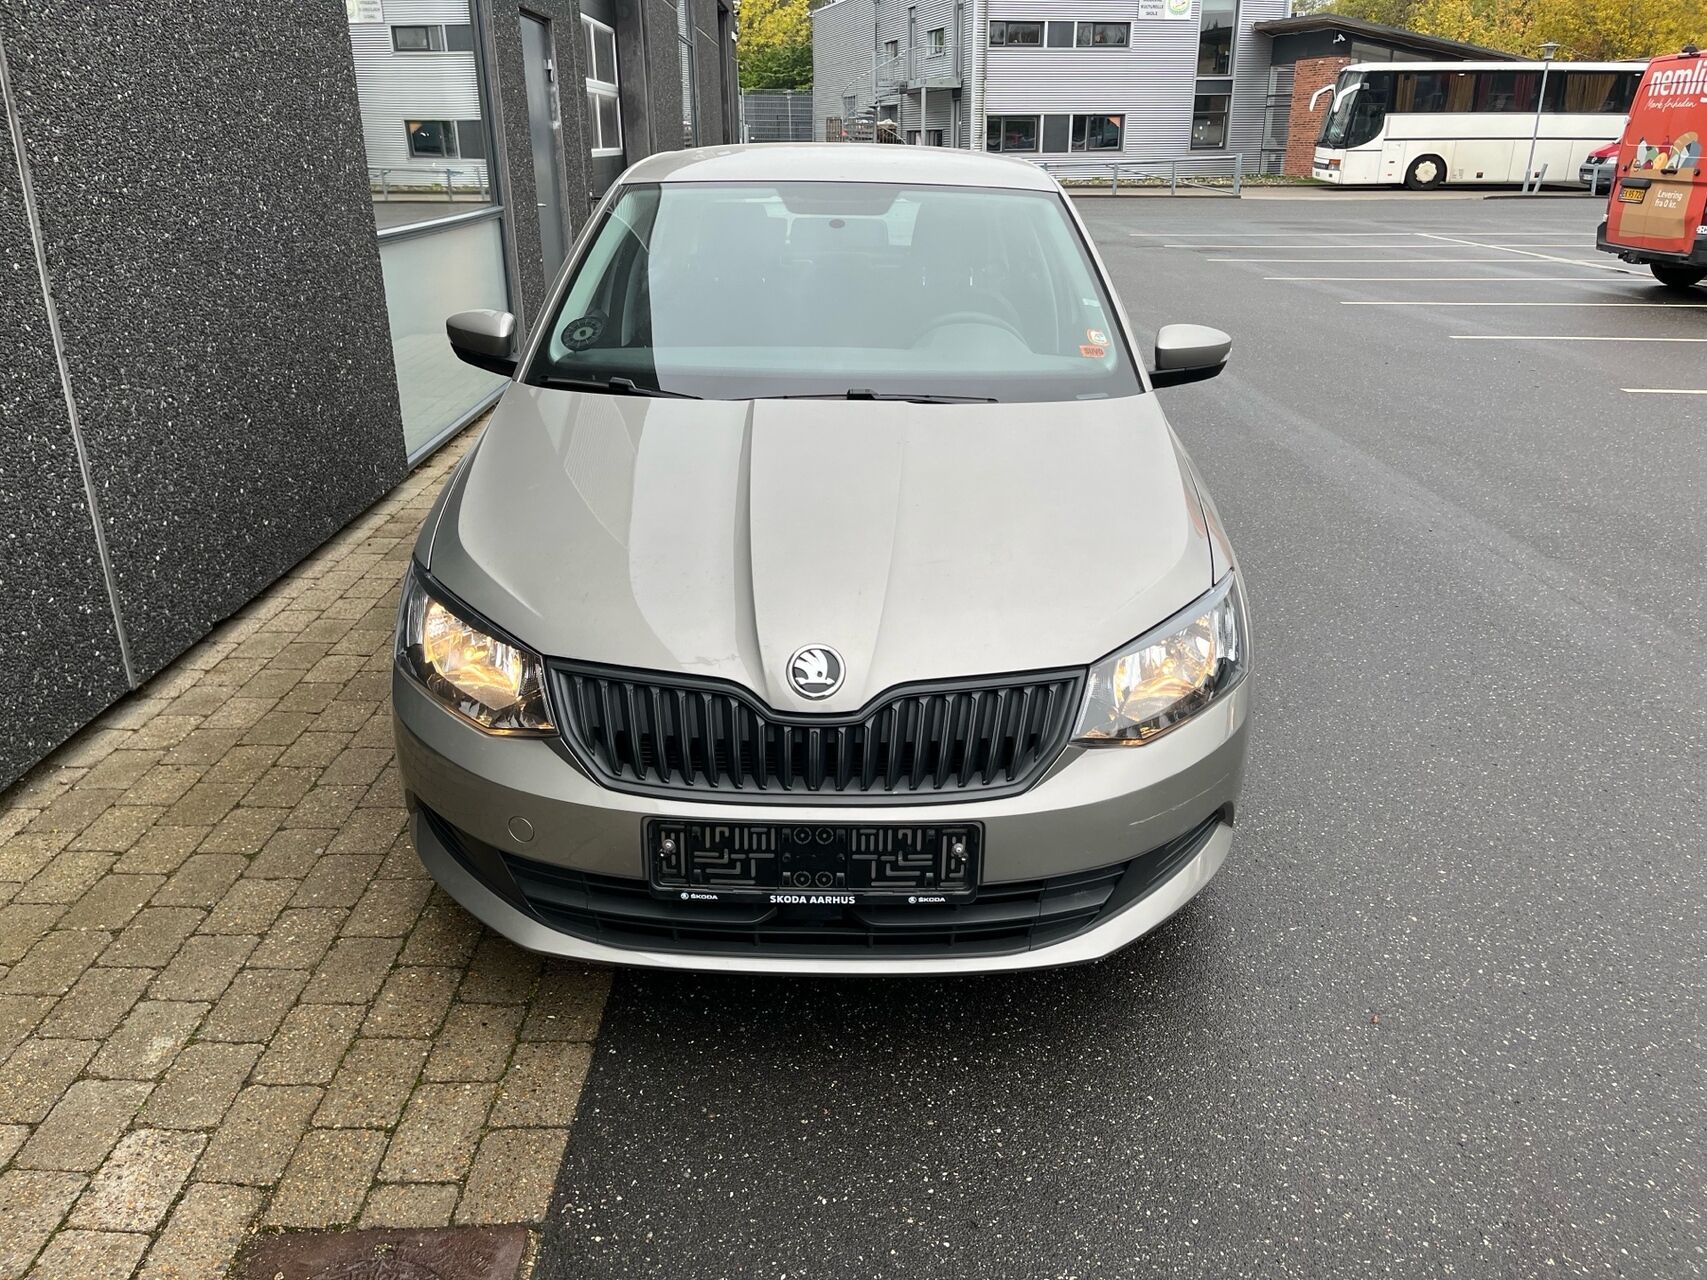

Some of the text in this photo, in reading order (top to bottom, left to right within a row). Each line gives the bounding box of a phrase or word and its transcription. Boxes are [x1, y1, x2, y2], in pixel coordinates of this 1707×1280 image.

[1657, 190, 1683, 201] Levering
[769, 895, 856, 904] SKODA AARHUS
